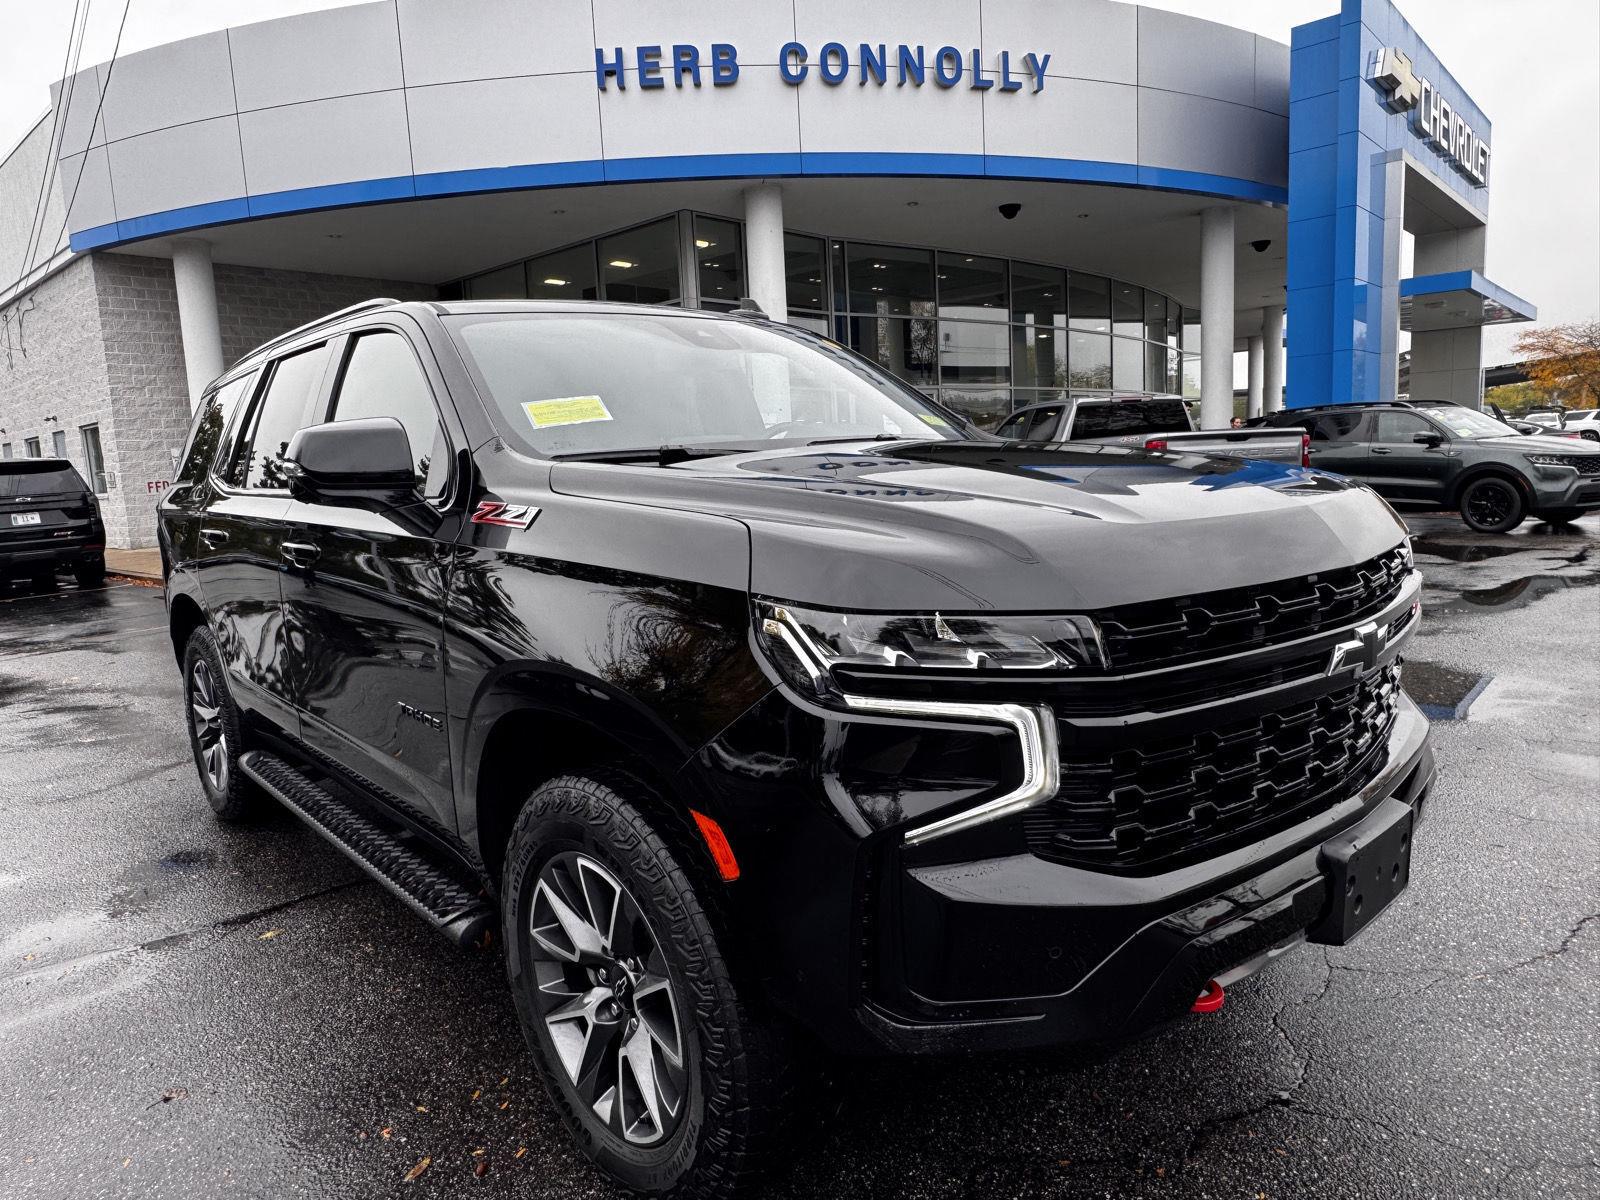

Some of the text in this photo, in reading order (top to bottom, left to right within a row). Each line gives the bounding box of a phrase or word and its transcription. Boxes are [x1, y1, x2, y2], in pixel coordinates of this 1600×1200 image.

[595, 41, 1051, 94] HERB CONNOLLY
[1420, 77, 1490, 187] CHEVROLET
[471, 501, 541, 531] Z71
[397, 701, 443, 733] TAHOE
